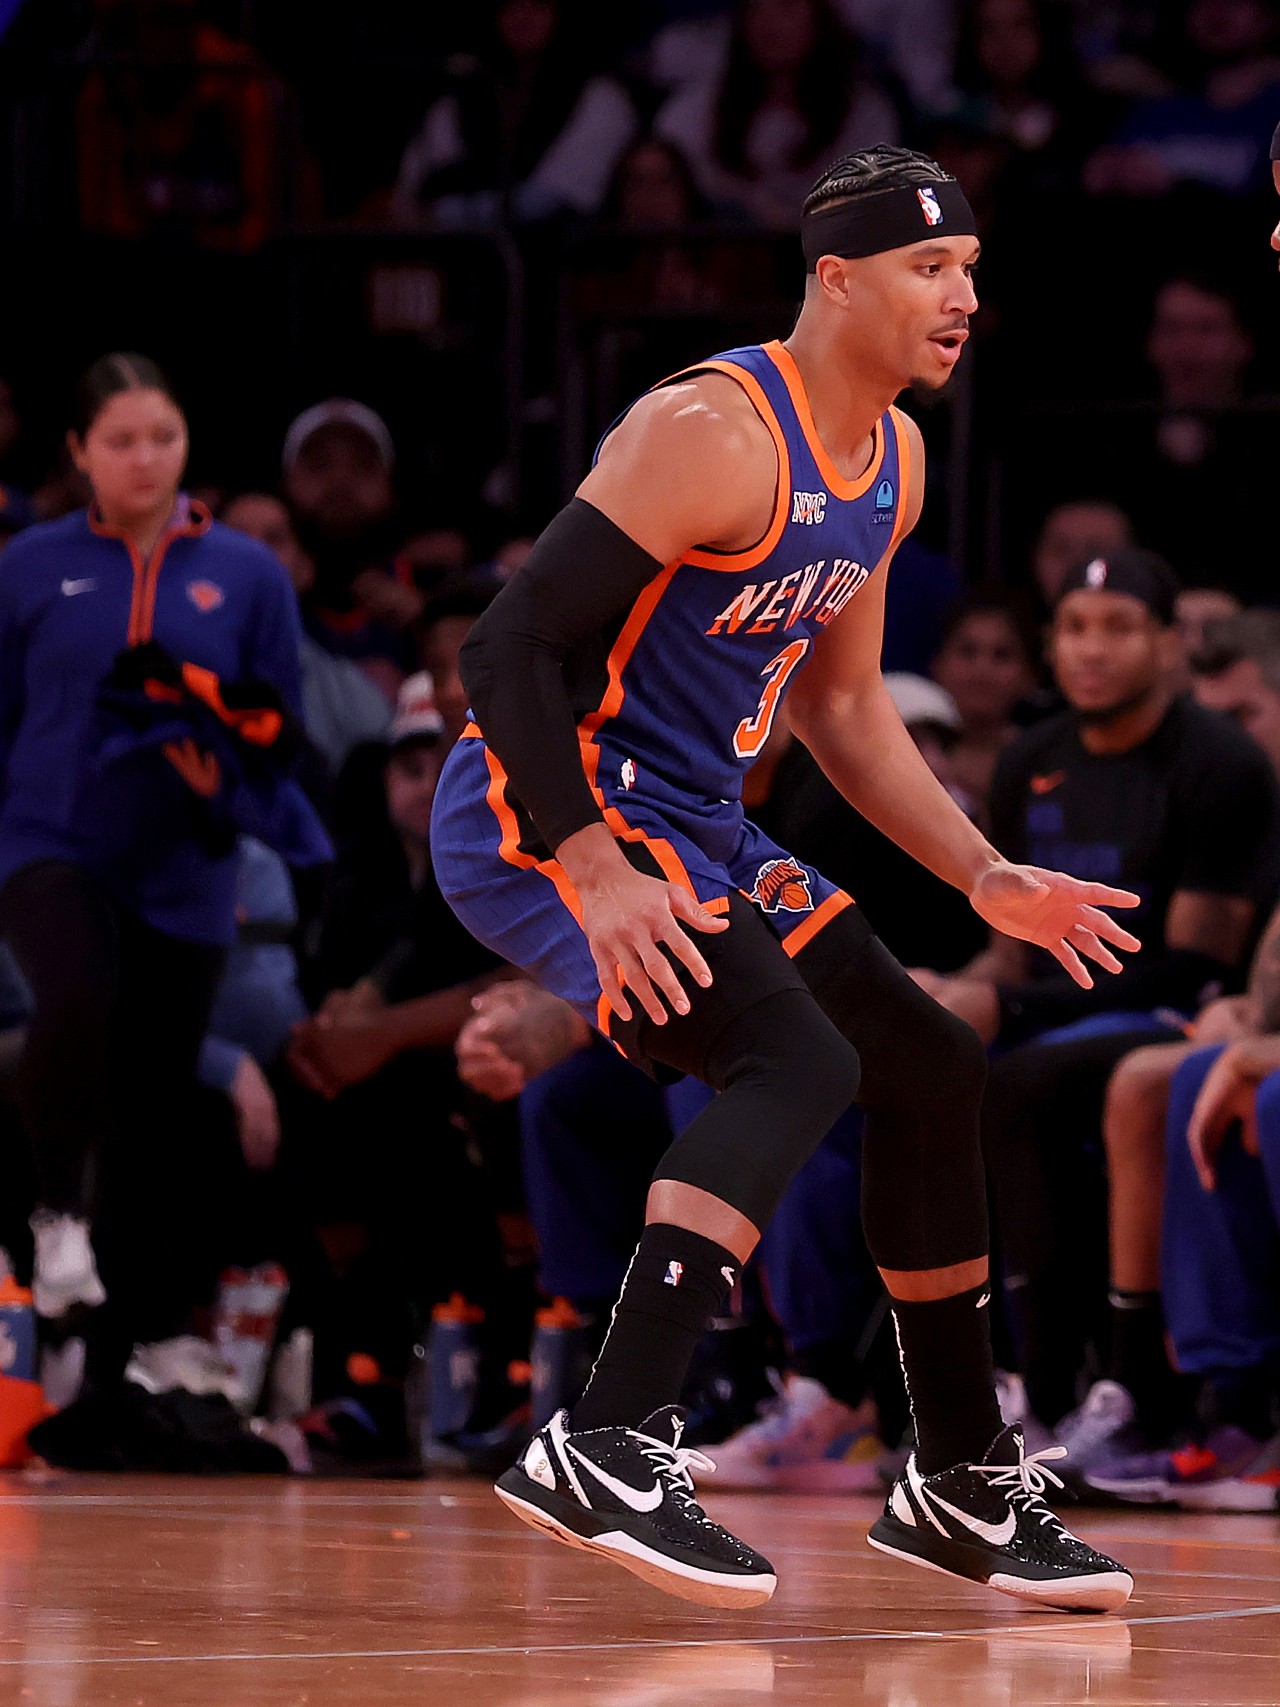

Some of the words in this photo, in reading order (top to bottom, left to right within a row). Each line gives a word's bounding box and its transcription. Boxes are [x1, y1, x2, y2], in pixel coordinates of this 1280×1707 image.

[791, 491, 827, 525] NYC
[705, 559, 826, 635] NEW
[801, 558, 870, 626] YOR
[732, 638, 810, 759] 3
